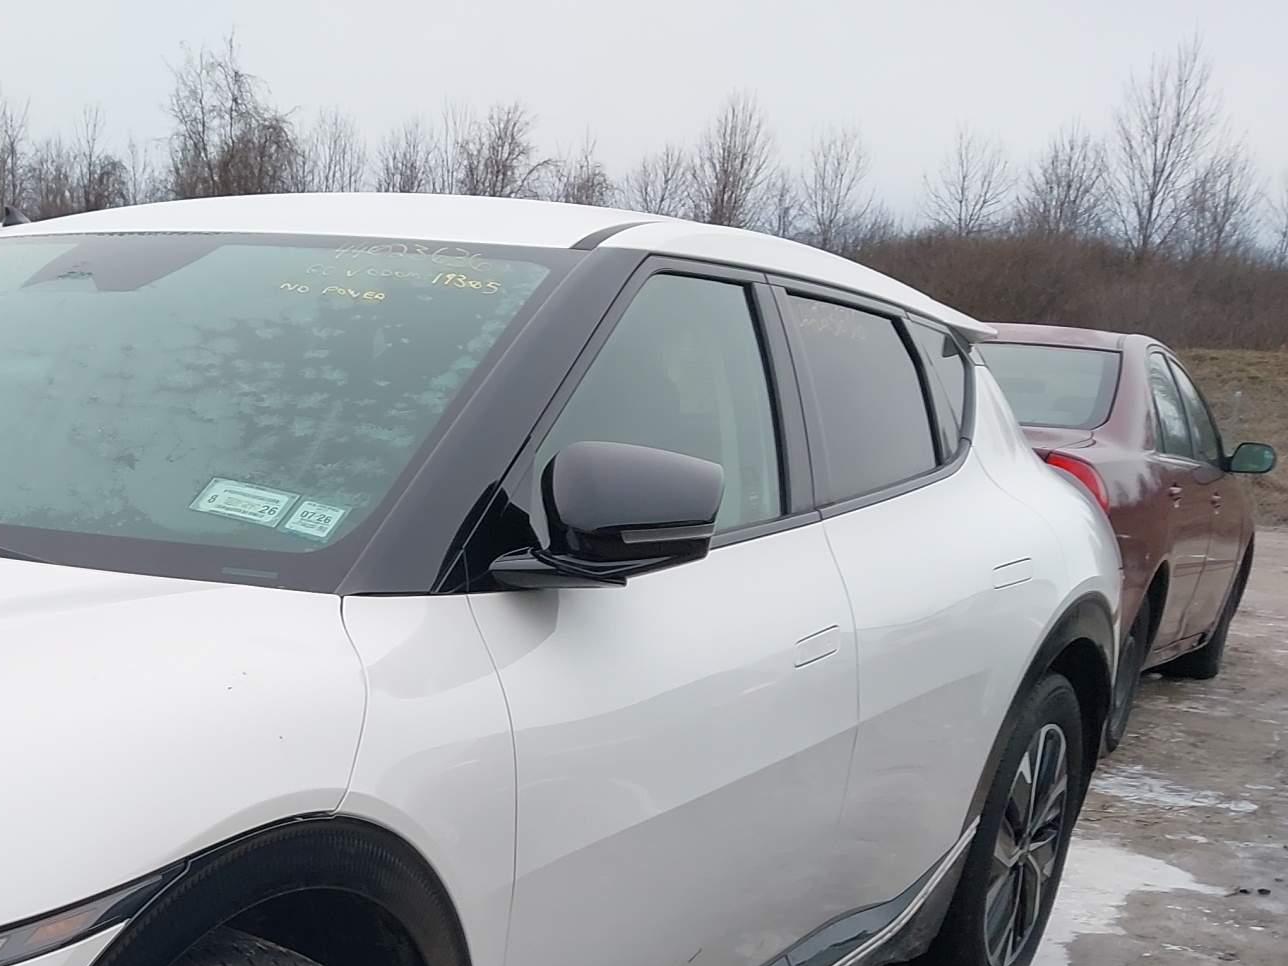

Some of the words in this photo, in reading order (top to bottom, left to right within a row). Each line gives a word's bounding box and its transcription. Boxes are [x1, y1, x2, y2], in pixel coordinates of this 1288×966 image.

[279, 281, 311, 294] NO
[321, 285, 387, 301] POWER
[258, 505, 279, 516] 26
